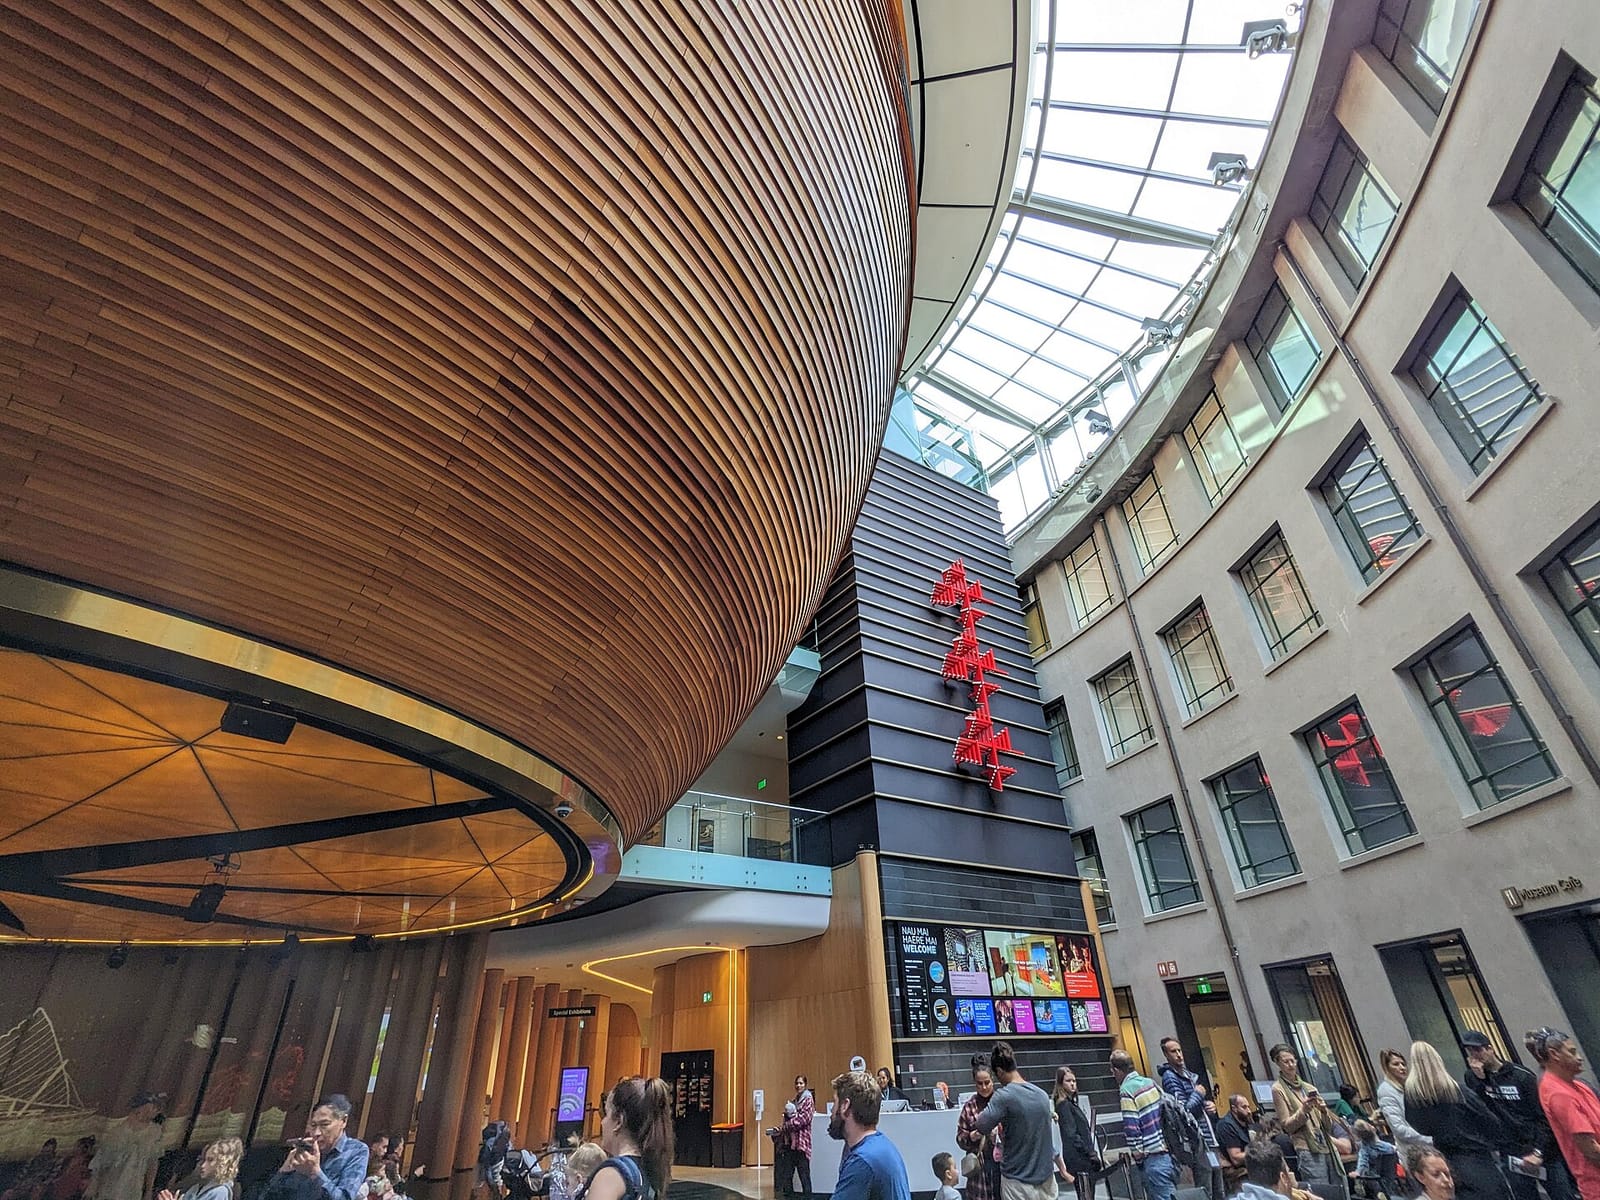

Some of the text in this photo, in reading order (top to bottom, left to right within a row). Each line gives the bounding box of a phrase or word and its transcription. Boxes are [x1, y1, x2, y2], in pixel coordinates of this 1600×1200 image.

[1520, 884, 1559, 901] Museum
[901, 926, 929, 937] NAU MAI
[902, 935, 938, 946] HAERE MAI
[902, 943, 937, 954] WELCOME
